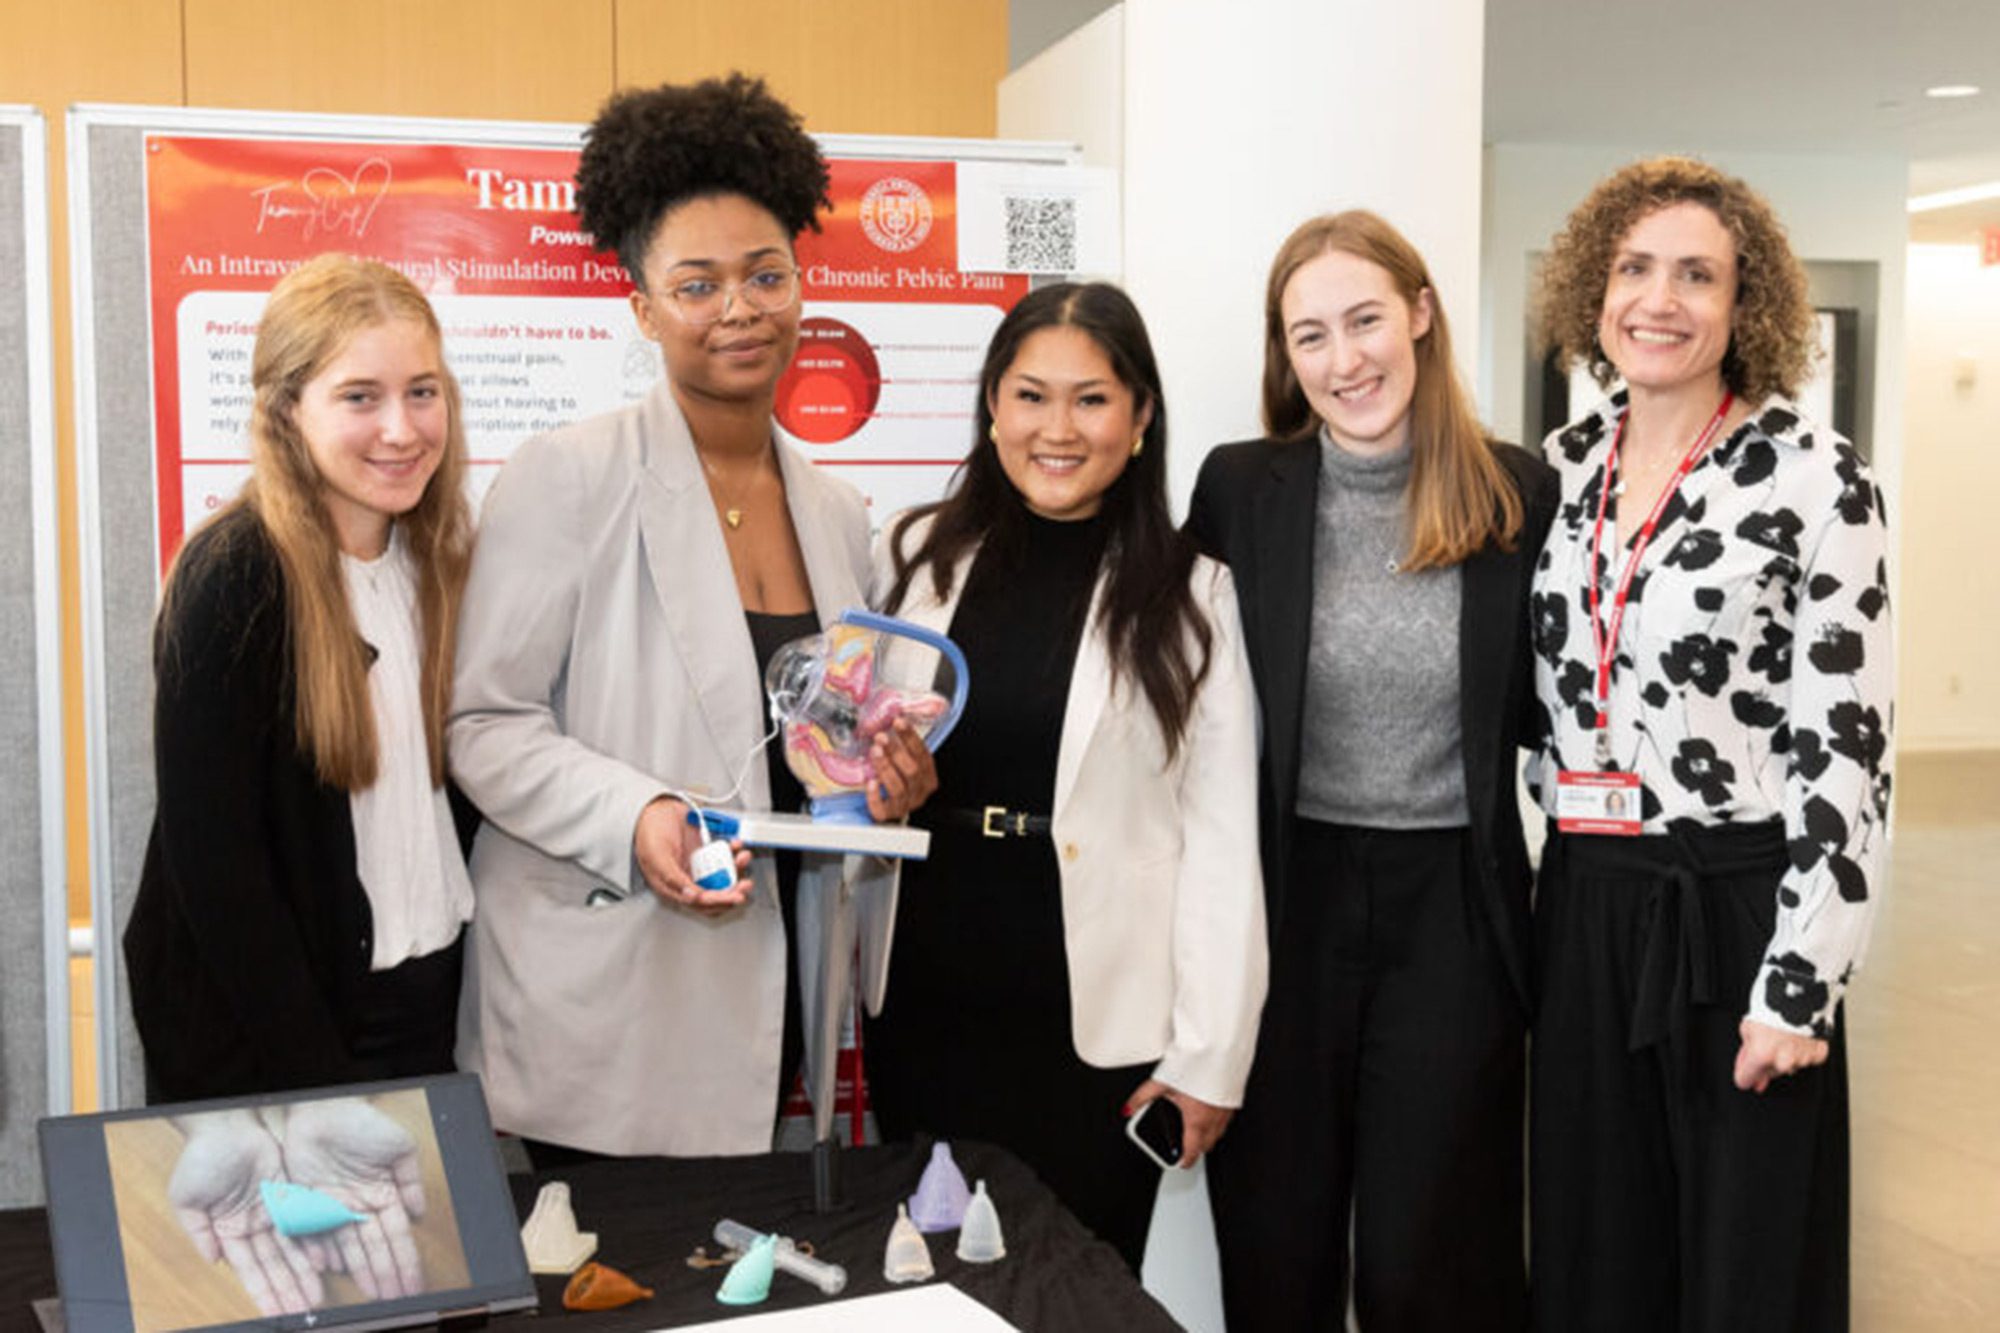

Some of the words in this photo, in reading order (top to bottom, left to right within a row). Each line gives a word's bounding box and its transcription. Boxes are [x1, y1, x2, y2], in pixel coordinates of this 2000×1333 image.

[180, 255, 212, 276] An
[447, 257, 576, 281] Stimulation
[806, 265, 891, 288] Chronic
[896, 268, 955, 290] Pelvic
[961, 272, 1005, 290] Pain
[526, 326, 563, 340] have
[569, 327, 583, 340] to
[208, 349, 248, 361] With
[481, 375, 530, 387] allows
[505, 397, 558, 412] having
[562, 397, 577, 410] to
